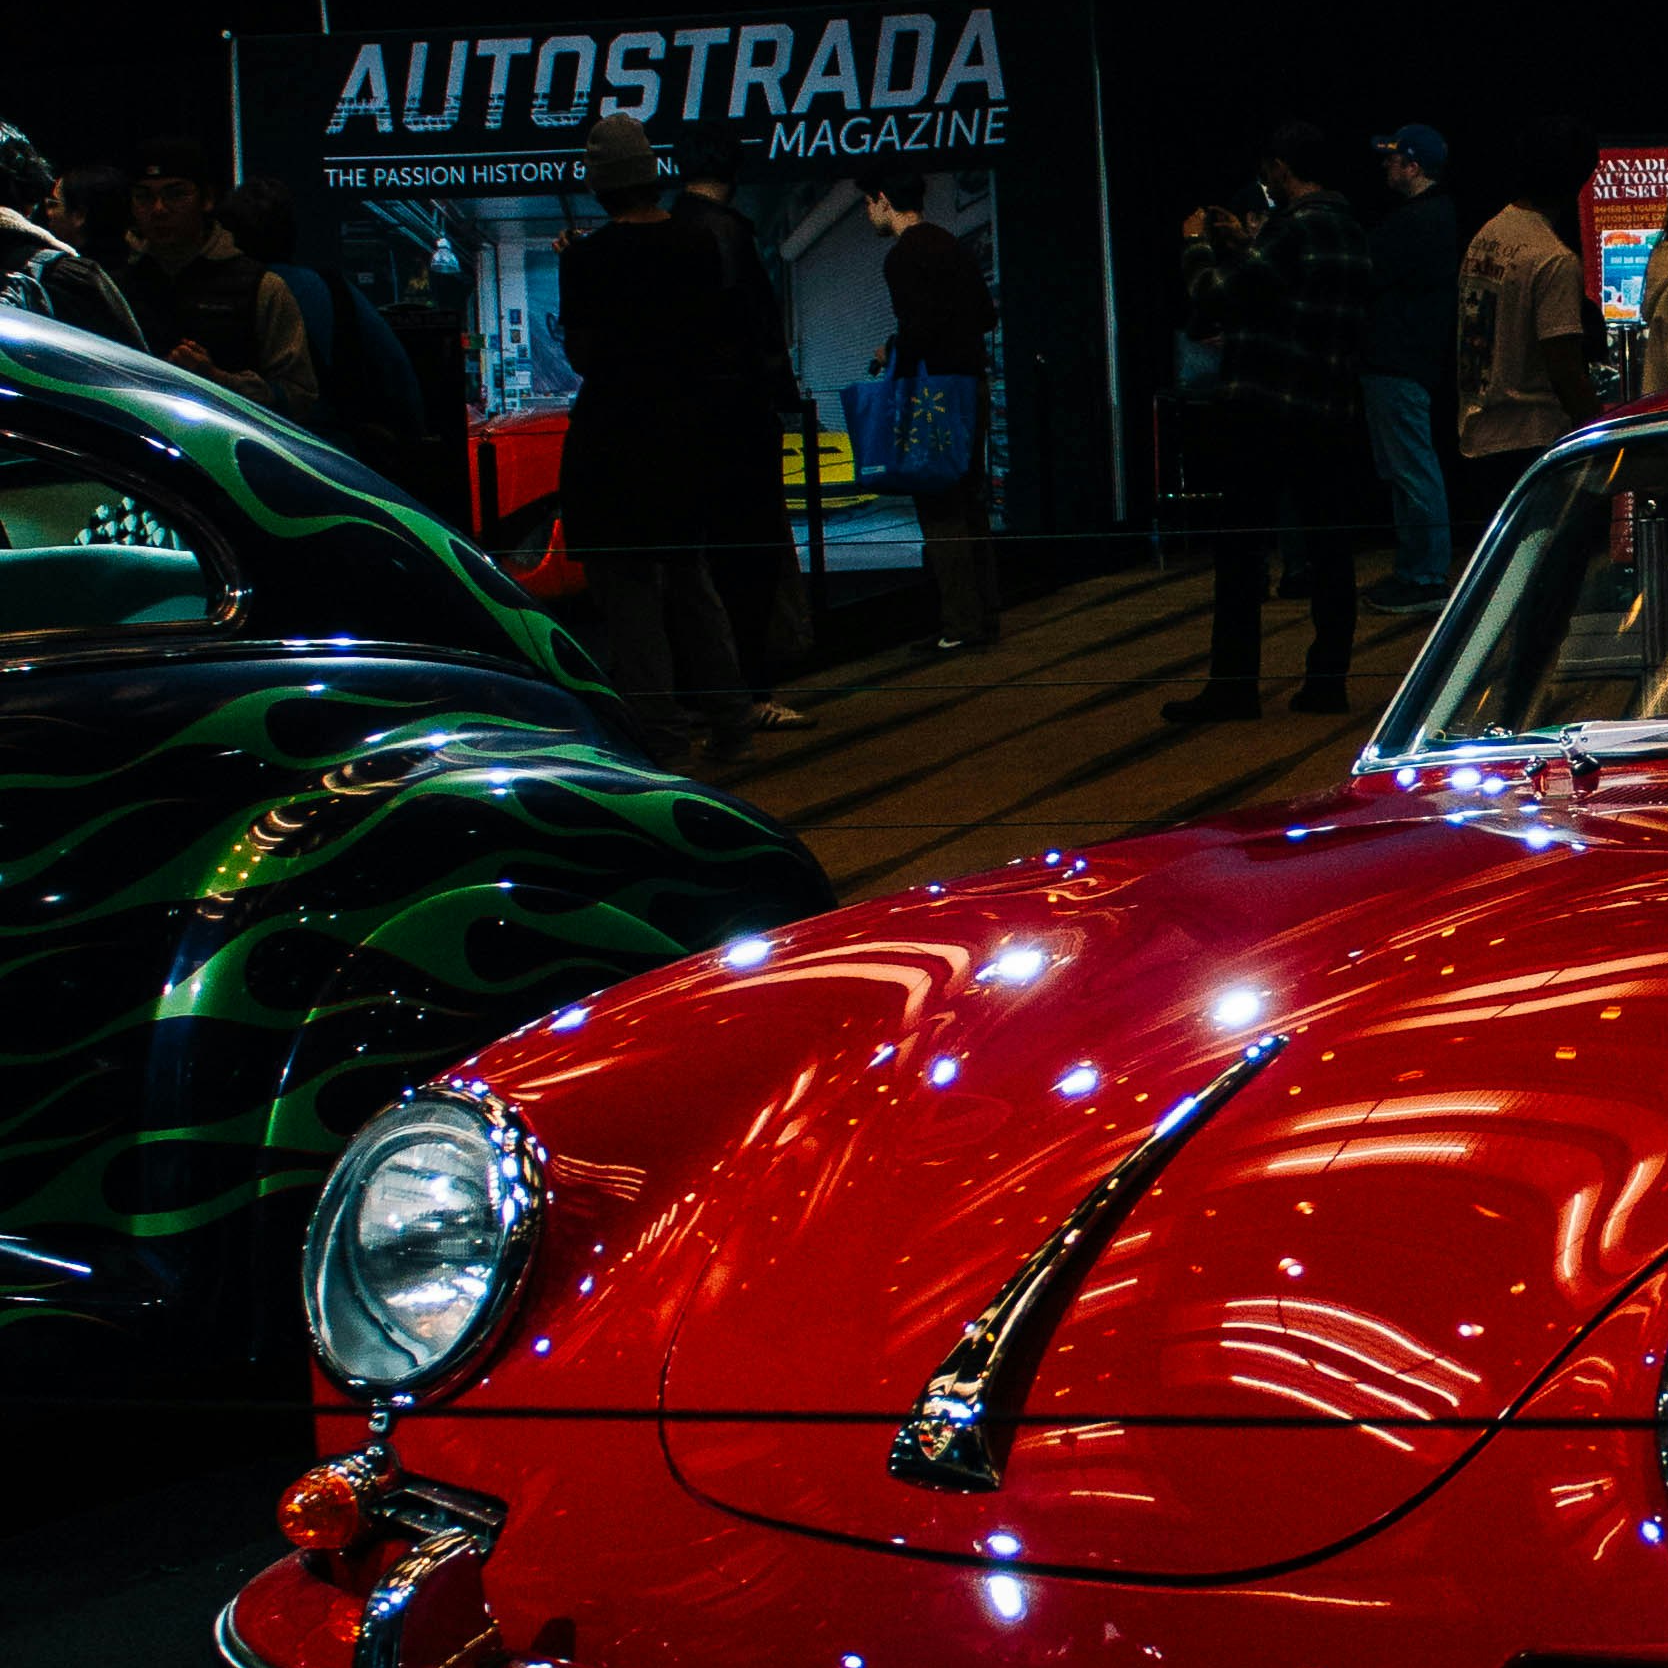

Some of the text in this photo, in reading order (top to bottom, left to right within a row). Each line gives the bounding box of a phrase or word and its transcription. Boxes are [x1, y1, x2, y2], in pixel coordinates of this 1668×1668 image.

[324, 9, 1006, 134] AUTOSTRADA
[768, 106, 1008, 160] MAGAZINE
[324, 160, 586, 189] THE PASSION HISTORY &
